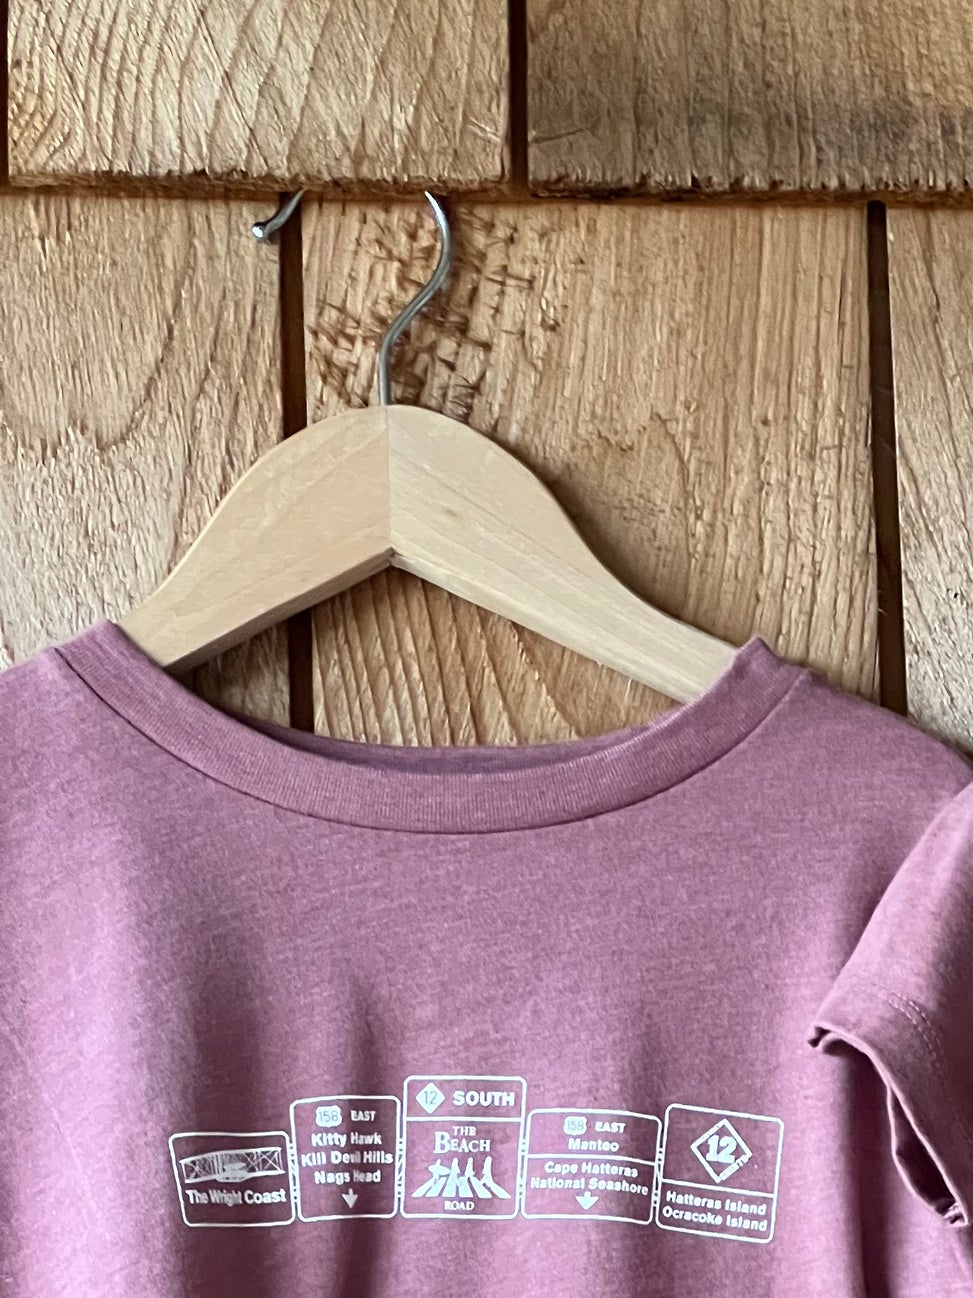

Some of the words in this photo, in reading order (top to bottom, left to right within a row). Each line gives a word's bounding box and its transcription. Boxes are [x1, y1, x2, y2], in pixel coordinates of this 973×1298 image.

[423, 1090, 438, 1105] 12
[452, 1090, 515, 1107] SOUTH
[318, 1110, 339, 1122] 158
[350, 1110, 376, 1122] EAST
[452, 1126, 477, 1136] THE
[567, 1120, 584, 1131] 158
[595, 1121, 626, 1133] EAST
[311, 1132, 347, 1148] Kitty
[350, 1132, 382, 1145] Hawk
[433, 1131, 491, 1154] BEACH
[568, 1138, 619, 1152] Manteo
[705, 1135, 737, 1164] 12
[301, 1151, 327, 1167] Kill
[330, 1150, 361, 1165] Devil
[363, 1150, 394, 1164] Hills
[313, 1170, 350, 1185] Nags
[353, 1169, 381, 1183] Head
[544, 1161, 579, 1176] Cape
[581, 1162, 638, 1178] Hatteras
[530, 1177, 585, 1189] National
[588, 1177, 649, 1196] Seashore
[185, 1189, 209, 1204] The
[208, 1189, 242, 1207] Wright
[243, 1188, 287, 1205] Coast
[444, 1200, 475, 1211] ROAD
[666, 1190, 722, 1209] Hatteras
[724, 1199, 767, 1216] Island
[662, 1205, 723, 1225] Ocracoke
[726, 1215, 768, 1232] Island
